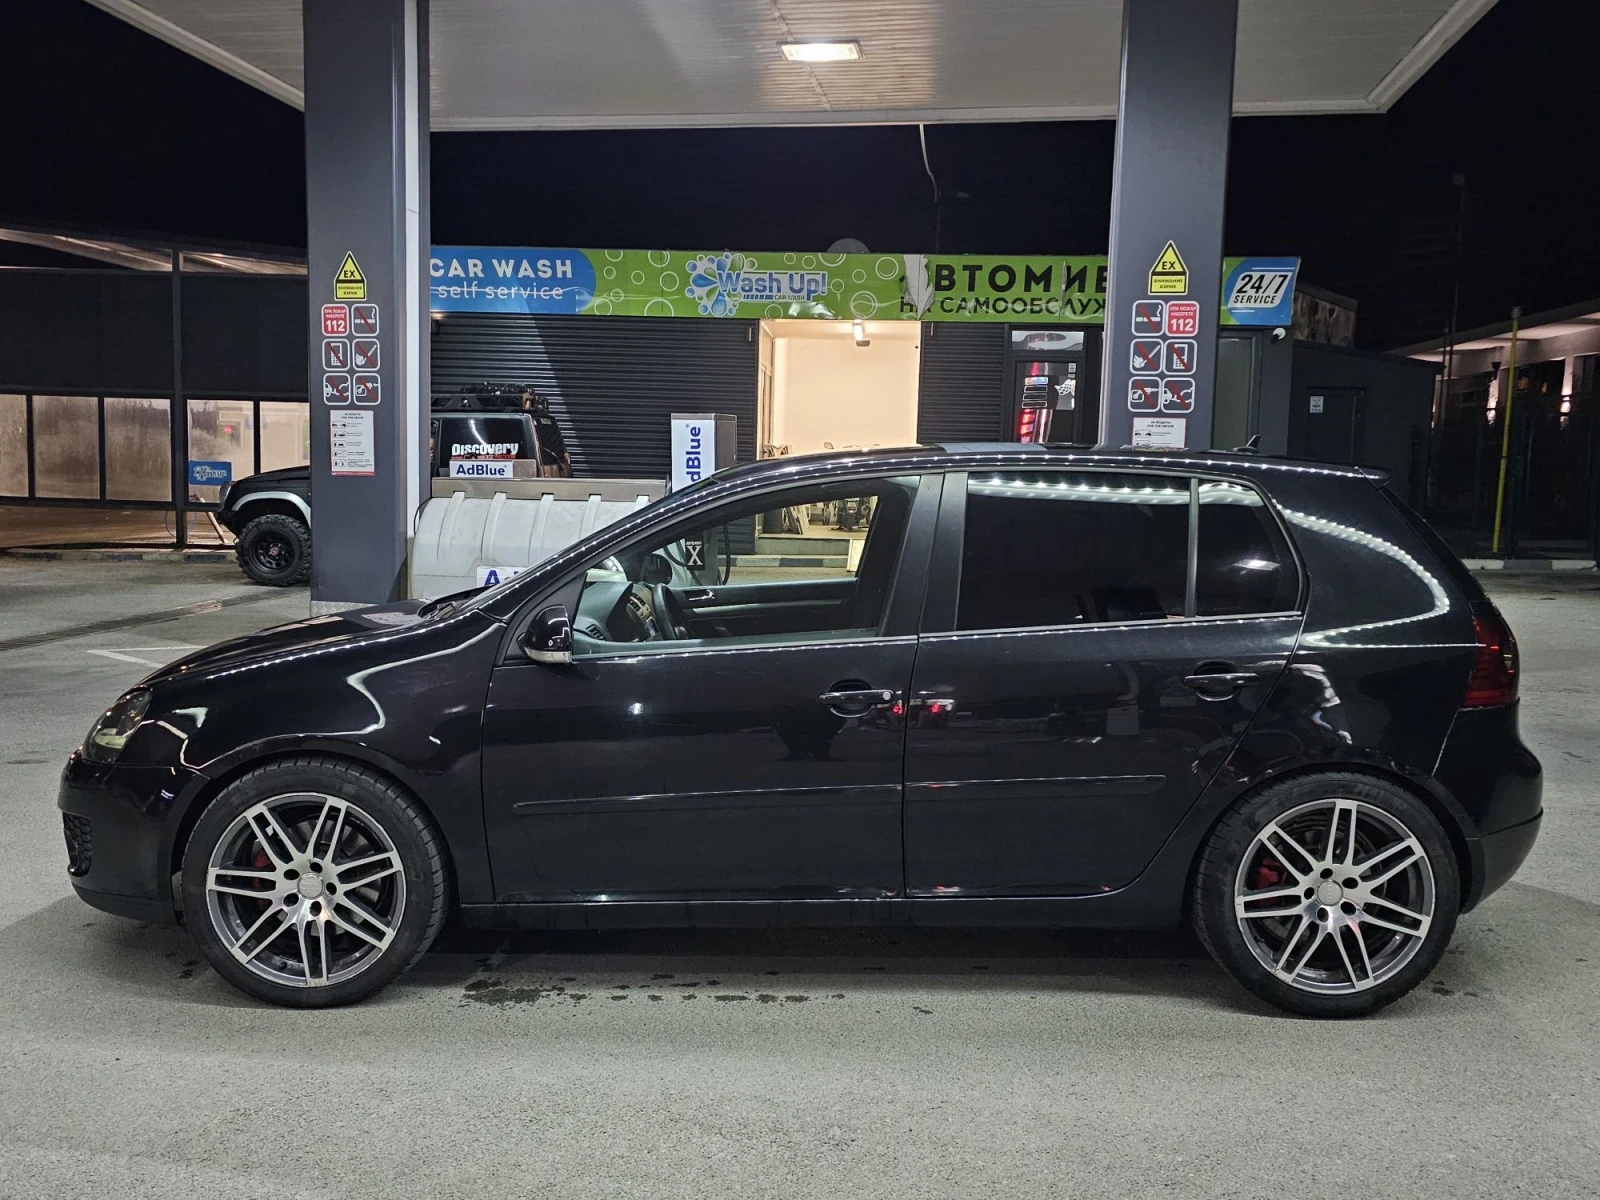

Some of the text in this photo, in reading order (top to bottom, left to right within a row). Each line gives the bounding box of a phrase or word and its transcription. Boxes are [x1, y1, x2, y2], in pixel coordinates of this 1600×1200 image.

[343, 269, 356, 278] EX
[430, 258, 573, 279] CAR WASH
[1161, 261, 1177, 270] EX
[717, 271, 827, 301] Wash Up!
[899, 264, 1108, 293] ВТОМИ
[1236, 273, 1288, 294] 24/7
[438, 281, 564, 300] self service
[1234, 294, 1278, 304] SERVICE
[900, 296, 932, 313] Н
[325, 319, 346, 332] 112
[1170, 319, 1194, 331] 112
[456, 464, 505, 476] AdBlue
[686, 545, 704, 566] X
